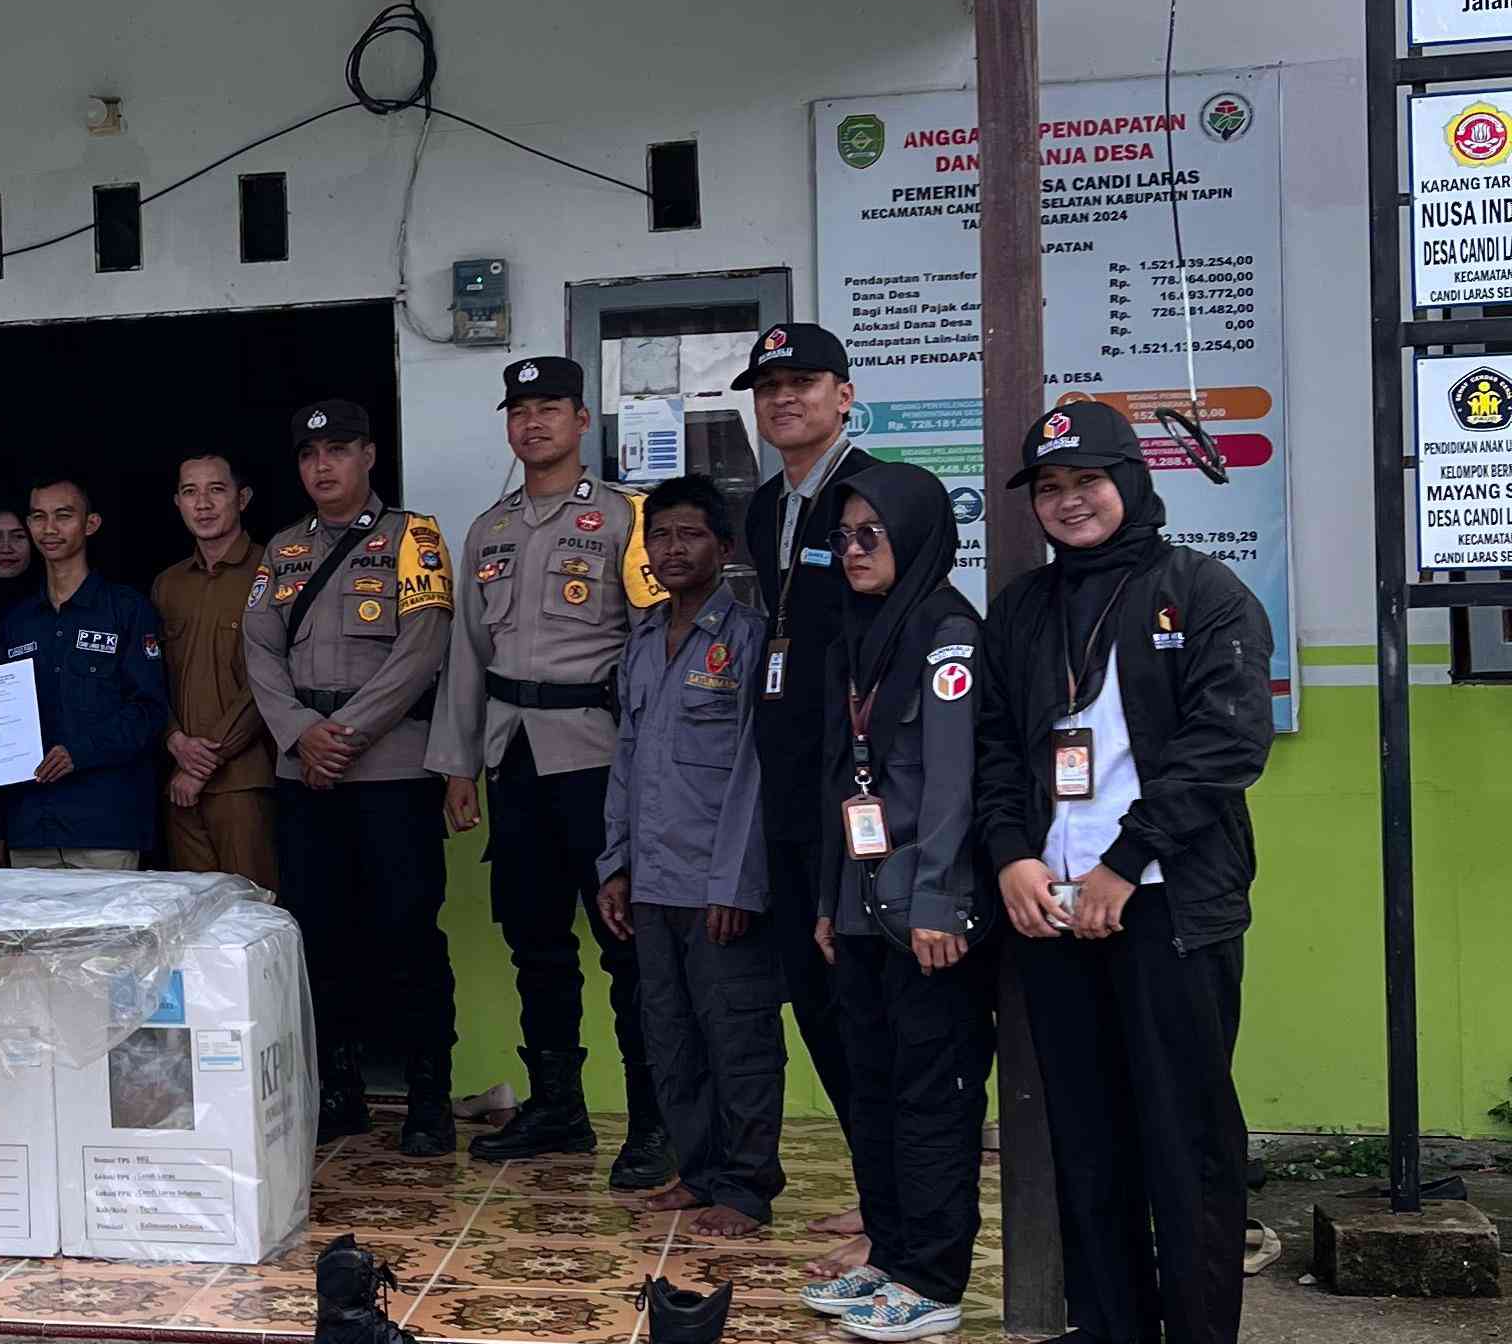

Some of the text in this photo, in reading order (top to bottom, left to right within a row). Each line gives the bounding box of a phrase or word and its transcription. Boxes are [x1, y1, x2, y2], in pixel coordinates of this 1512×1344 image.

[903, 113, 1186, 149] ANGGA PENDAPATAN
[1094, 143, 1154, 162] DESA
[892, 169, 1200, 202] PEMERIN SA CANDI LARAS
[1421, 177, 1481, 194] KARANG
[861, 206, 942, 220] KECAMATAN
[1041, 195, 1102, 209] SELATAN
[1106, 190, 1188, 205] KABUPATEN
[1191, 187, 1232, 199] TAPIN
[1041, 210, 1128, 225] GARAN 2024
[1422, 200, 1477, 228] NUSA
[1424, 239, 1457, 266] DESA
[1460, 236, 1500, 264] CANDI
[1109, 262, 1131, 274] Rp.
[844, 271, 978, 287] Pendapatan Transfer
[1109, 272, 1254, 290] Rp. 778.64.000,00
[852, 290, 920, 302] Dana Desa
[1109, 294, 1131, 306] Rp.
[1430, 289, 1461, 302] CANDI
[1463, 287, 1495, 301] LARAS
[852, 306, 881, 318] Bagi
[885, 305, 917, 315] Hasil
[921, 303, 957, 315] Pajak
[1110, 310, 1132, 321] Rp.
[853, 318, 973, 332] Alokasi Dana Desa
[1110, 319, 1255, 336] Rp. 0,00
[845, 333, 979, 348] Pendapatan Lain-lain
[1101, 344, 1125, 357] Rp.
[847, 351, 984, 368] JUMLAH PENDAPAT
[1064, 372, 1103, 384] DESA
[1424, 441, 1478, 455] PENDIDIKAN
[1480, 439, 1504, 453] ANAK
[1440, 464, 1489, 479] KELOMPOK
[1427, 483, 1500, 501] MAYANG
[1428, 508, 1461, 528] DESA
[1464, 507, 1503, 526] CANDI
[349, 555, 396, 569] POLRI
[1434, 552, 1465, 564] CANDI
[1467, 550, 1499, 563] LARAS
